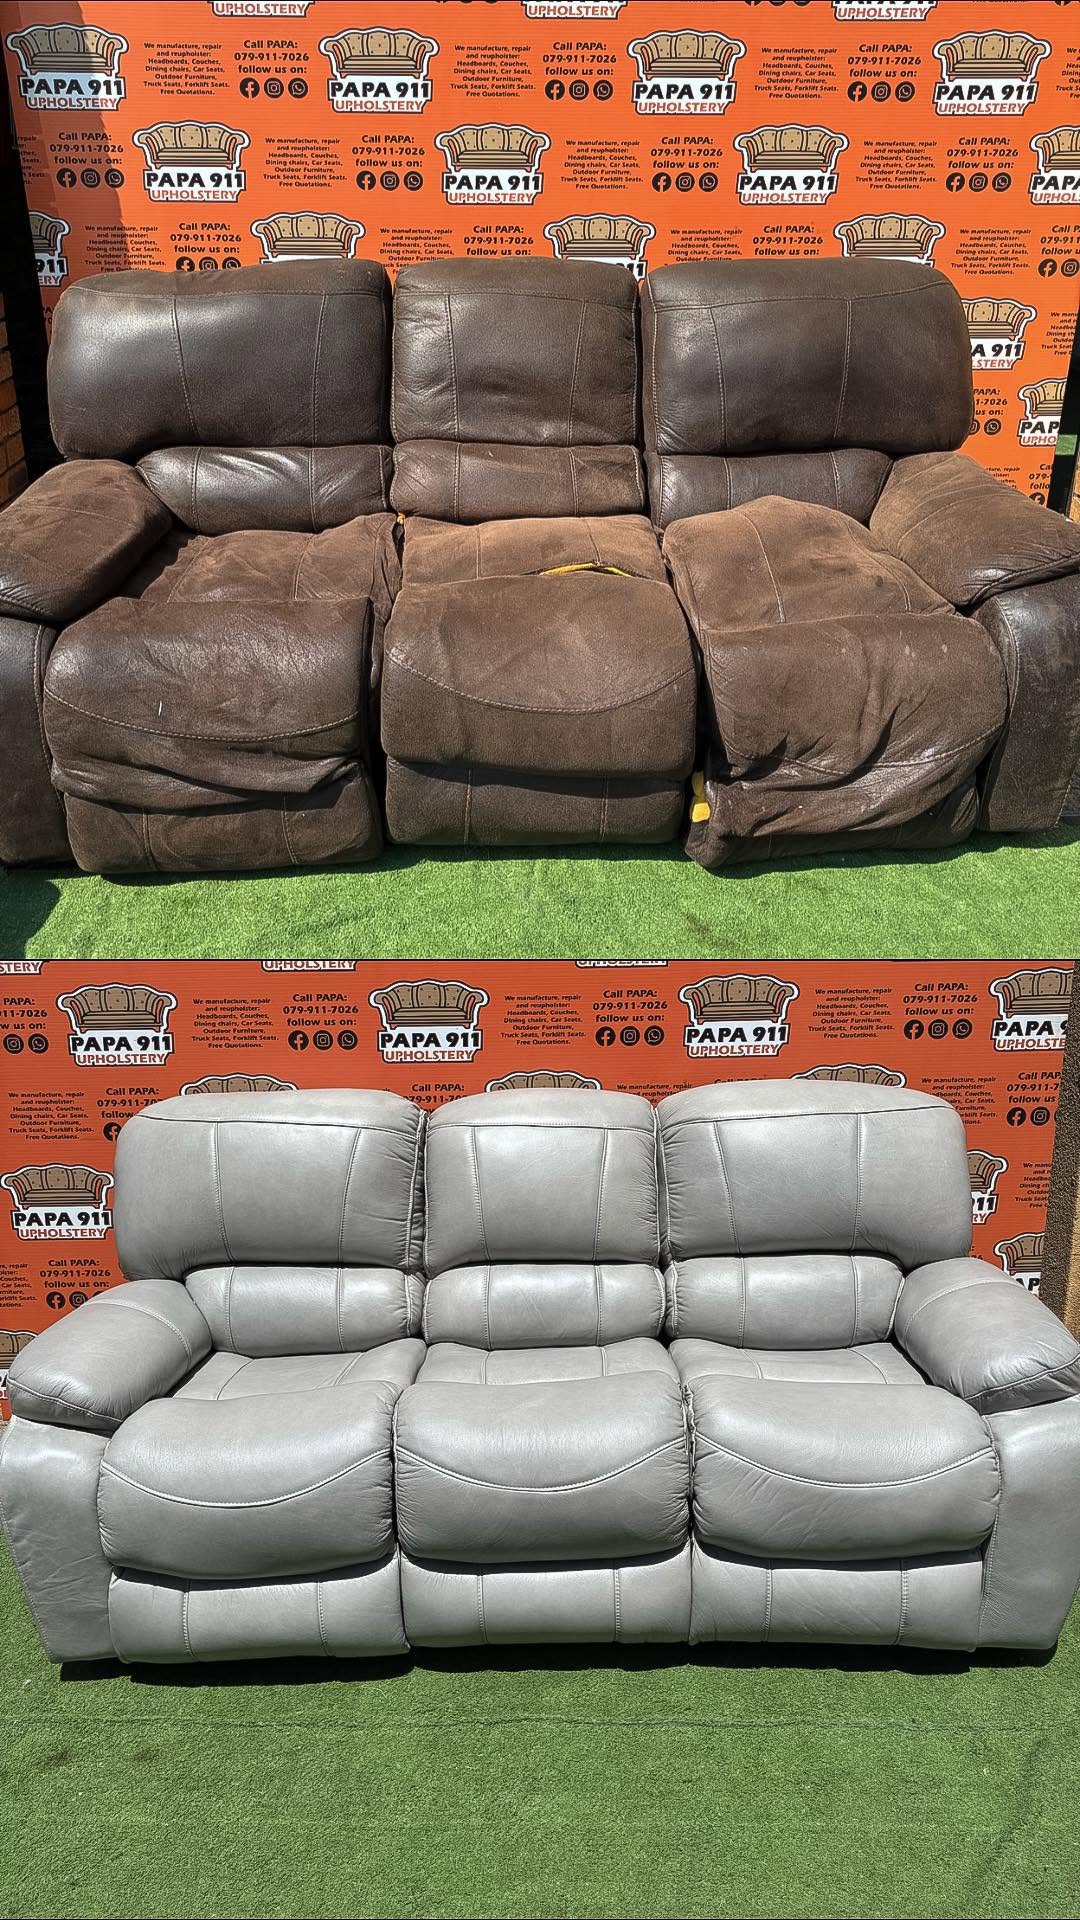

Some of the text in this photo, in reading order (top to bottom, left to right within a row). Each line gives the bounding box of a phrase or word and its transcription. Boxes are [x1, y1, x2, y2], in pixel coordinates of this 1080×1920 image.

[215, 3, 306, 13] UPHOLSTERY
[529, 6, 618, 16] UPHOLSTERY
[838, 8, 927, 18] UPHOLSTERY
[244, 40, 298, 48] Call PAPA:
[553, 42, 606, 50] Call PAPA:
[859, 44, 912, 52] Call PAPA:
[234, 52, 310, 61] 079-911-7026
[542, 54, 616, 63] 079-911-7026
[848, 56, 921, 65] 079-911-7026
[238, 65, 271, 73] follow
[545, 67, 578, 75] follow
[850, 68, 882, 77] follow
[22, 79, 122, 94] PAPA 911
[331, 82, 430, 98] PAPA 911
[635, 84, 734, 100] PAPA 911
[936, 85, 1035, 100] PAPA 911
[28, 98, 116, 108] UPHOLSTERY
[336, 100, 422, 110] UPHOLSTERY
[639, 102, 725, 112] UPHOLSTERY
[939, 103, 1025, 113] UPHOLSTERY
[58, 132, 112, 141] Call PAPA:
[684, 136, 713, 144] PAPA:
[958, 137, 1010, 145] Call PAPA:
[50, 144, 124, 153] 079-911-7026
[651, 148, 723, 156] 079-911-7026
[947, 149, 1018, 157] 079-911-7026
[54, 156, 87, 164] follow
[653, 160, 685, 168] follow
[948, 160, 980, 168] follow
[146, 173, 243, 187] PAPA 911
[445, 176, 540, 190] PAPA 911
[739, 176, 835, 190] PAPA 911
[152, 190, 237, 200] UPHOLSTERY
[449, 193, 534, 202] UPHOLSTERY
[742, 193, 827, 202] UPHOLSTERY
[170, 234, 242, 242] 079-911-7026
[464, 236, 534, 244] 079-911-7026
[991, 344, 1022, 357] 911
[914, 983, 968, 991] Call PAPA:
[292, 993, 347, 1002] Call PAPA:
[603, 990, 657, 998] Call PAPA:
[903, 994, 978, 1004] 079-911-7026
[283, 1006, 358, 1014] 079-911-7026
[593, 1001, 668, 1010] 079-911-7026
[287, 1018, 320, 1026] follow
[994, 1021, 1054, 1036] PAPA
[687, 1027, 786, 1043] PAPA 911
[71, 1036, 171, 1051] PAPA 911
[381, 1033, 480, 1048] PAPA 911
[692, 1045, 779, 1055] UPHOLSTERY
[78, 1054, 164, 1064] UPHOLSTERY
[386, 1050, 472, 1060] UPHOLSTERY
[15, 1212, 110, 1226] PAPA 911
[21, 1229, 106, 1238] UPHOLSTERY
